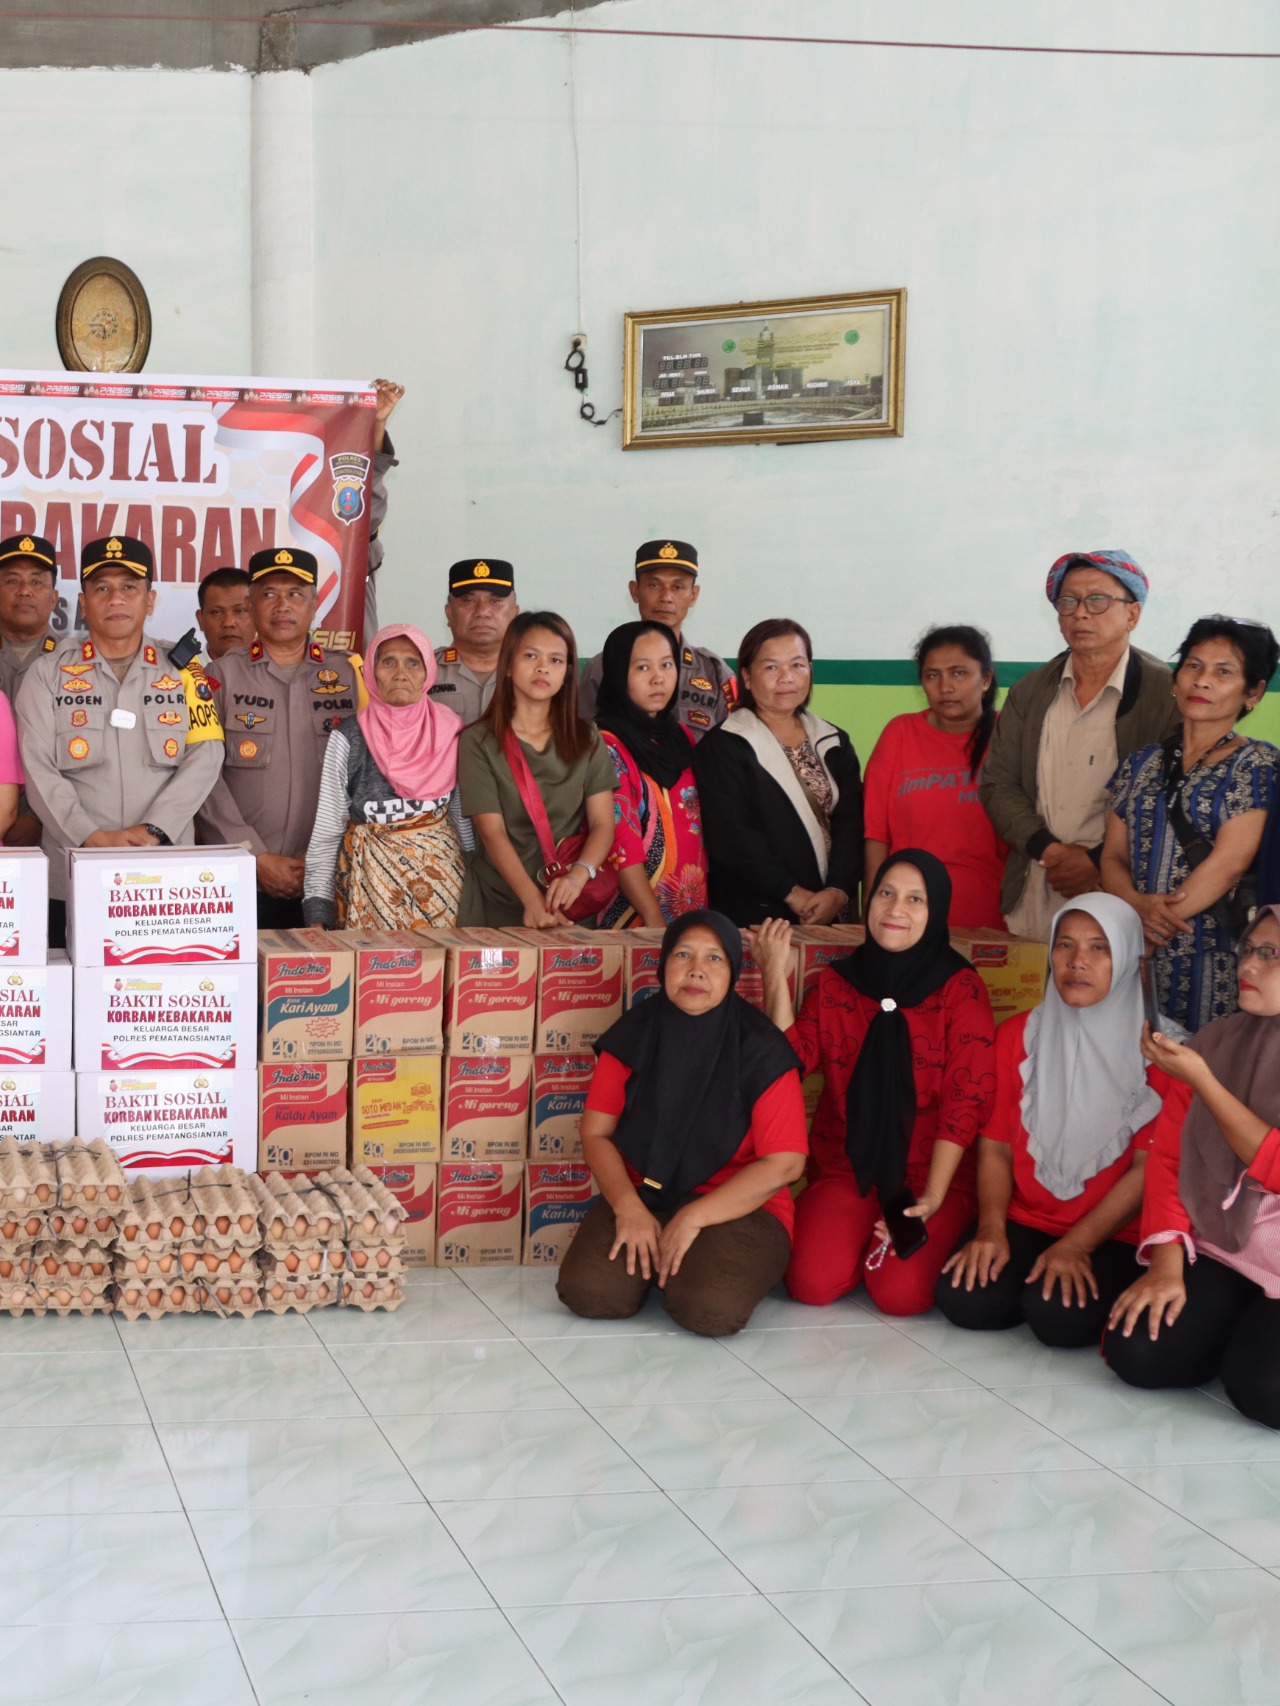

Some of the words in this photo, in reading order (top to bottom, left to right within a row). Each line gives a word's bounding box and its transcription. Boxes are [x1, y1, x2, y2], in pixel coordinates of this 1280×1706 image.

[46, 385, 80, 393] PRESISI
[100, 386, 134, 395] PRESISI
[154, 388, 186, 396] PRESISI
[206, 390, 240, 398] PRESISI
[259, 392, 292, 400] PRESISI
[312, 394, 344, 402] PRESISI
[55, 696, 102, 706] YOGEN
[234, 694, 274, 709] YUDI
[313, 699, 354, 710] POLRI
[682, 690, 717, 709] POLRI
[188, 704, 220, 730] AOPS
[110, 888, 164, 903] BAKTI
[169, 885, 232, 900] SOSIAL
[108, 904, 157, 918] KORBAN
[159, 901, 233, 916] KEBAKARAN
[135, 918, 180, 927] KELUARGA
[184, 917, 211, 925] BESAR
[115, 929, 148, 937] POLRES
[151, 925, 234, 936] PEMATANGSIANTAR
[110, 995, 163, 1007] BAKTI
[169, 995, 231, 1008] SOSIAL
[390, 997, 432, 1007] goreng
[488, 996, 528, 1006] goreng
[572, 993, 612, 1003] goreng
[280, 1002, 305, 1013] Kari
[305, 1003, 338, 1015] Ayam
[107, 1010, 156, 1022] KORBAN
[158, 1010, 232, 1023] KEBAKARAN
[105, 1094, 159, 1108] BAKTI
[164, 1091, 226, 1106] SOSIAL
[362, 1104, 378, 1115] SOTO
[380, 1102, 401, 1112] MEDAN
[478, 1102, 519, 1112] goreng
[547, 1099, 572, 1110] Kari
[572, 1100, 585, 1113] Ay
[104, 1109, 152, 1123] KORBAN
[155, 1106, 227, 1122] KEBAKARAN
[275, 1110, 305, 1120] Kaldu
[309, 1111, 337, 1122] Ayam
[131, 1124, 175, 1132] KELUARGA
[178, 1122, 205, 1130] BESAR
[111, 1134, 143, 1142] POLRES
[147, 1130, 228, 1141] PEMATANGSIANTAR
[470, 1207, 511, 1217] goreng
[542, 1209, 566, 1219] Kari
